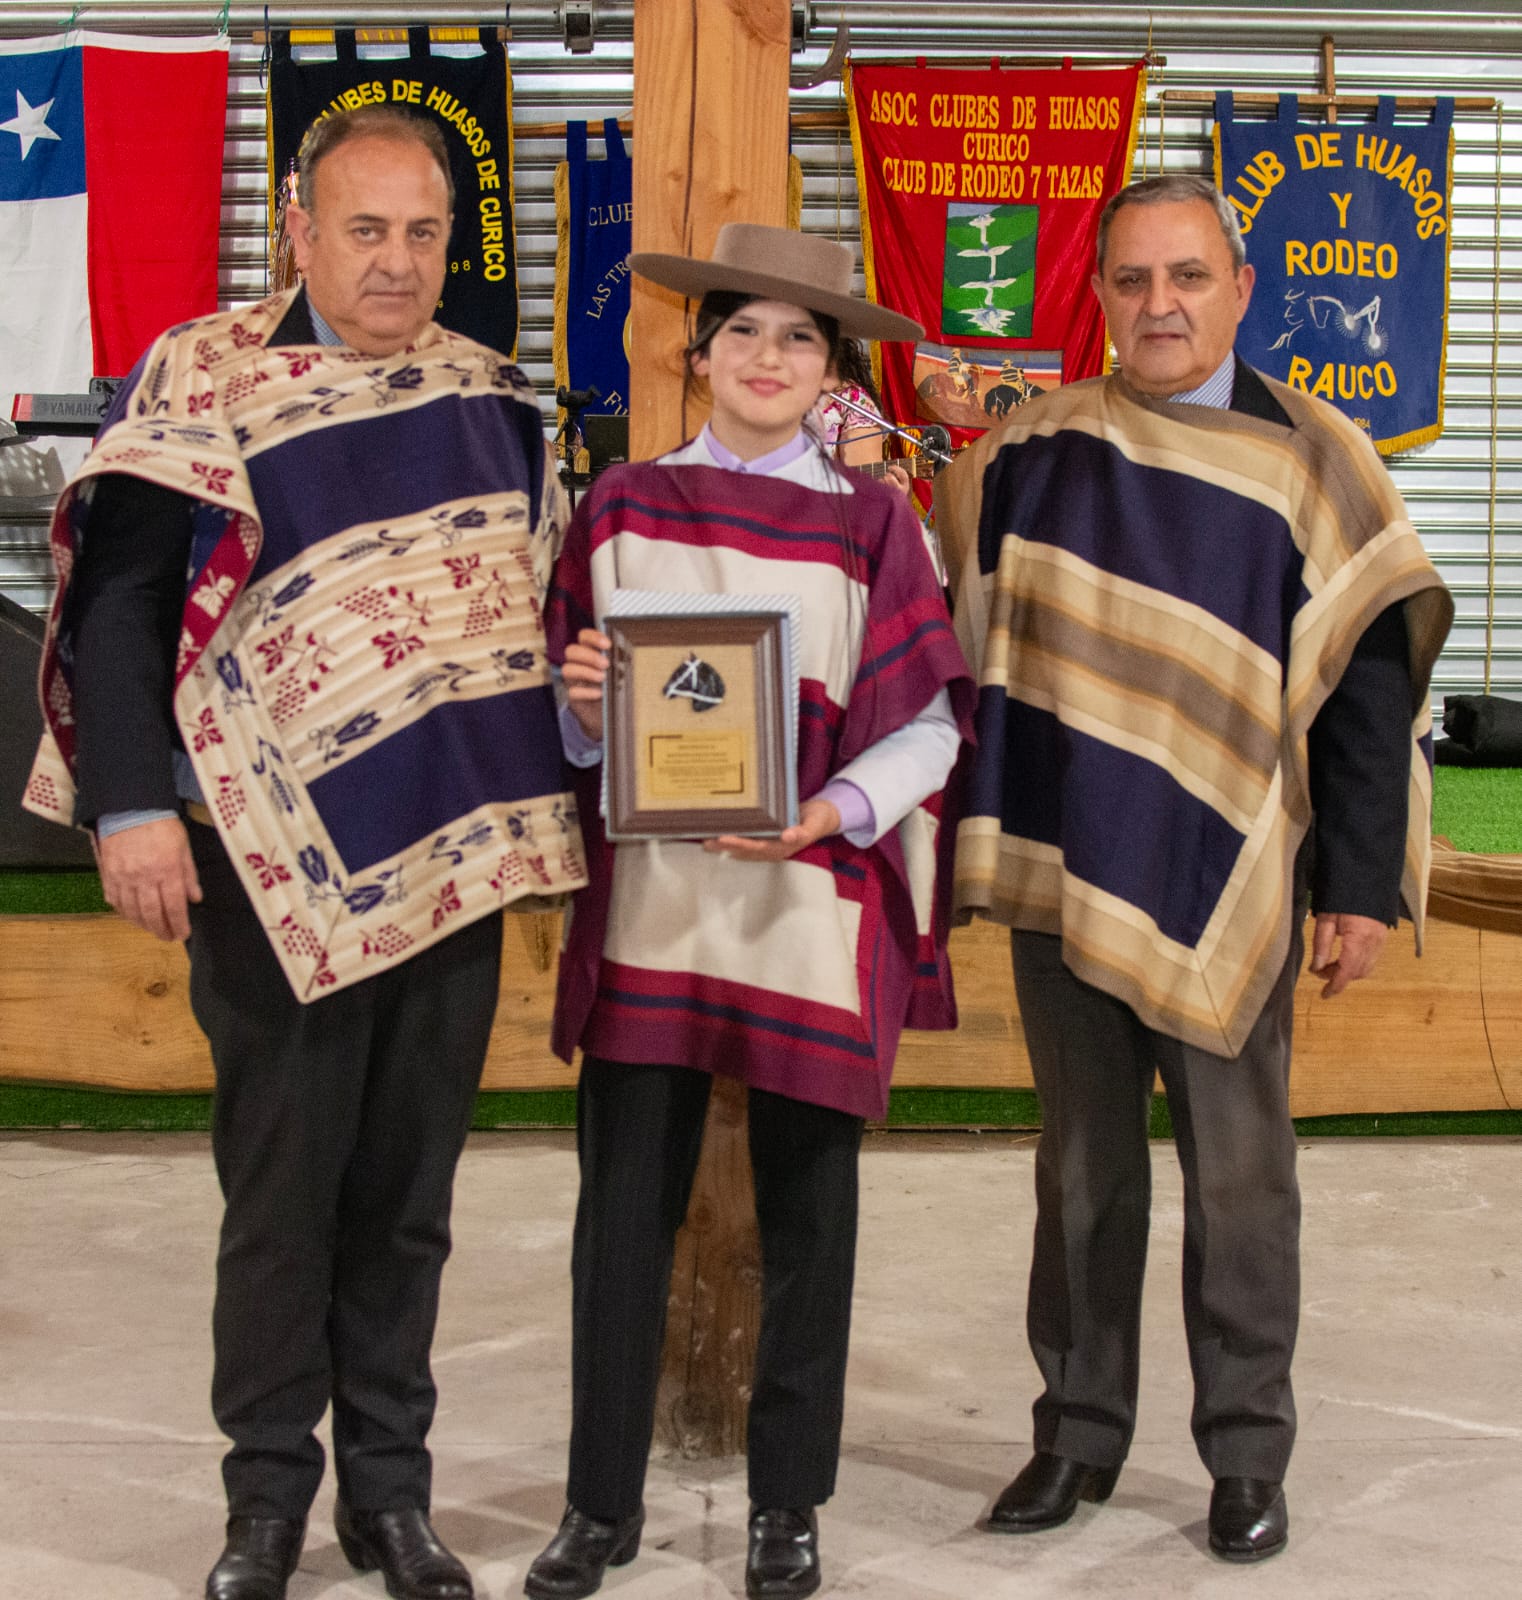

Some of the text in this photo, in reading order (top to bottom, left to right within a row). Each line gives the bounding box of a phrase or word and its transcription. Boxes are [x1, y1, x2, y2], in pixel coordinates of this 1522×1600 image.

[392, 79, 423, 104] DE
[870, 89, 1120, 131] ASOC. CLUBES DE HUASOS
[425, 86, 491, 158] HUASOS
[963, 132, 1030, 162] CURICO
[476, 159, 500, 191] DE
[882, 156, 1104, 199] CLUB DE RODEO 7 TAZAS
[1294, 132, 1343, 170] DE
[1355, 133, 1447, 240] HUASOS
[1329, 192, 1352, 228] Y
[479, 197, 506, 282] CURICO
[1285, 239, 1398, 279] RODEO
[585, 259, 632, 320] LAS TR
[1287, 355, 1397, 400] RAUCO
